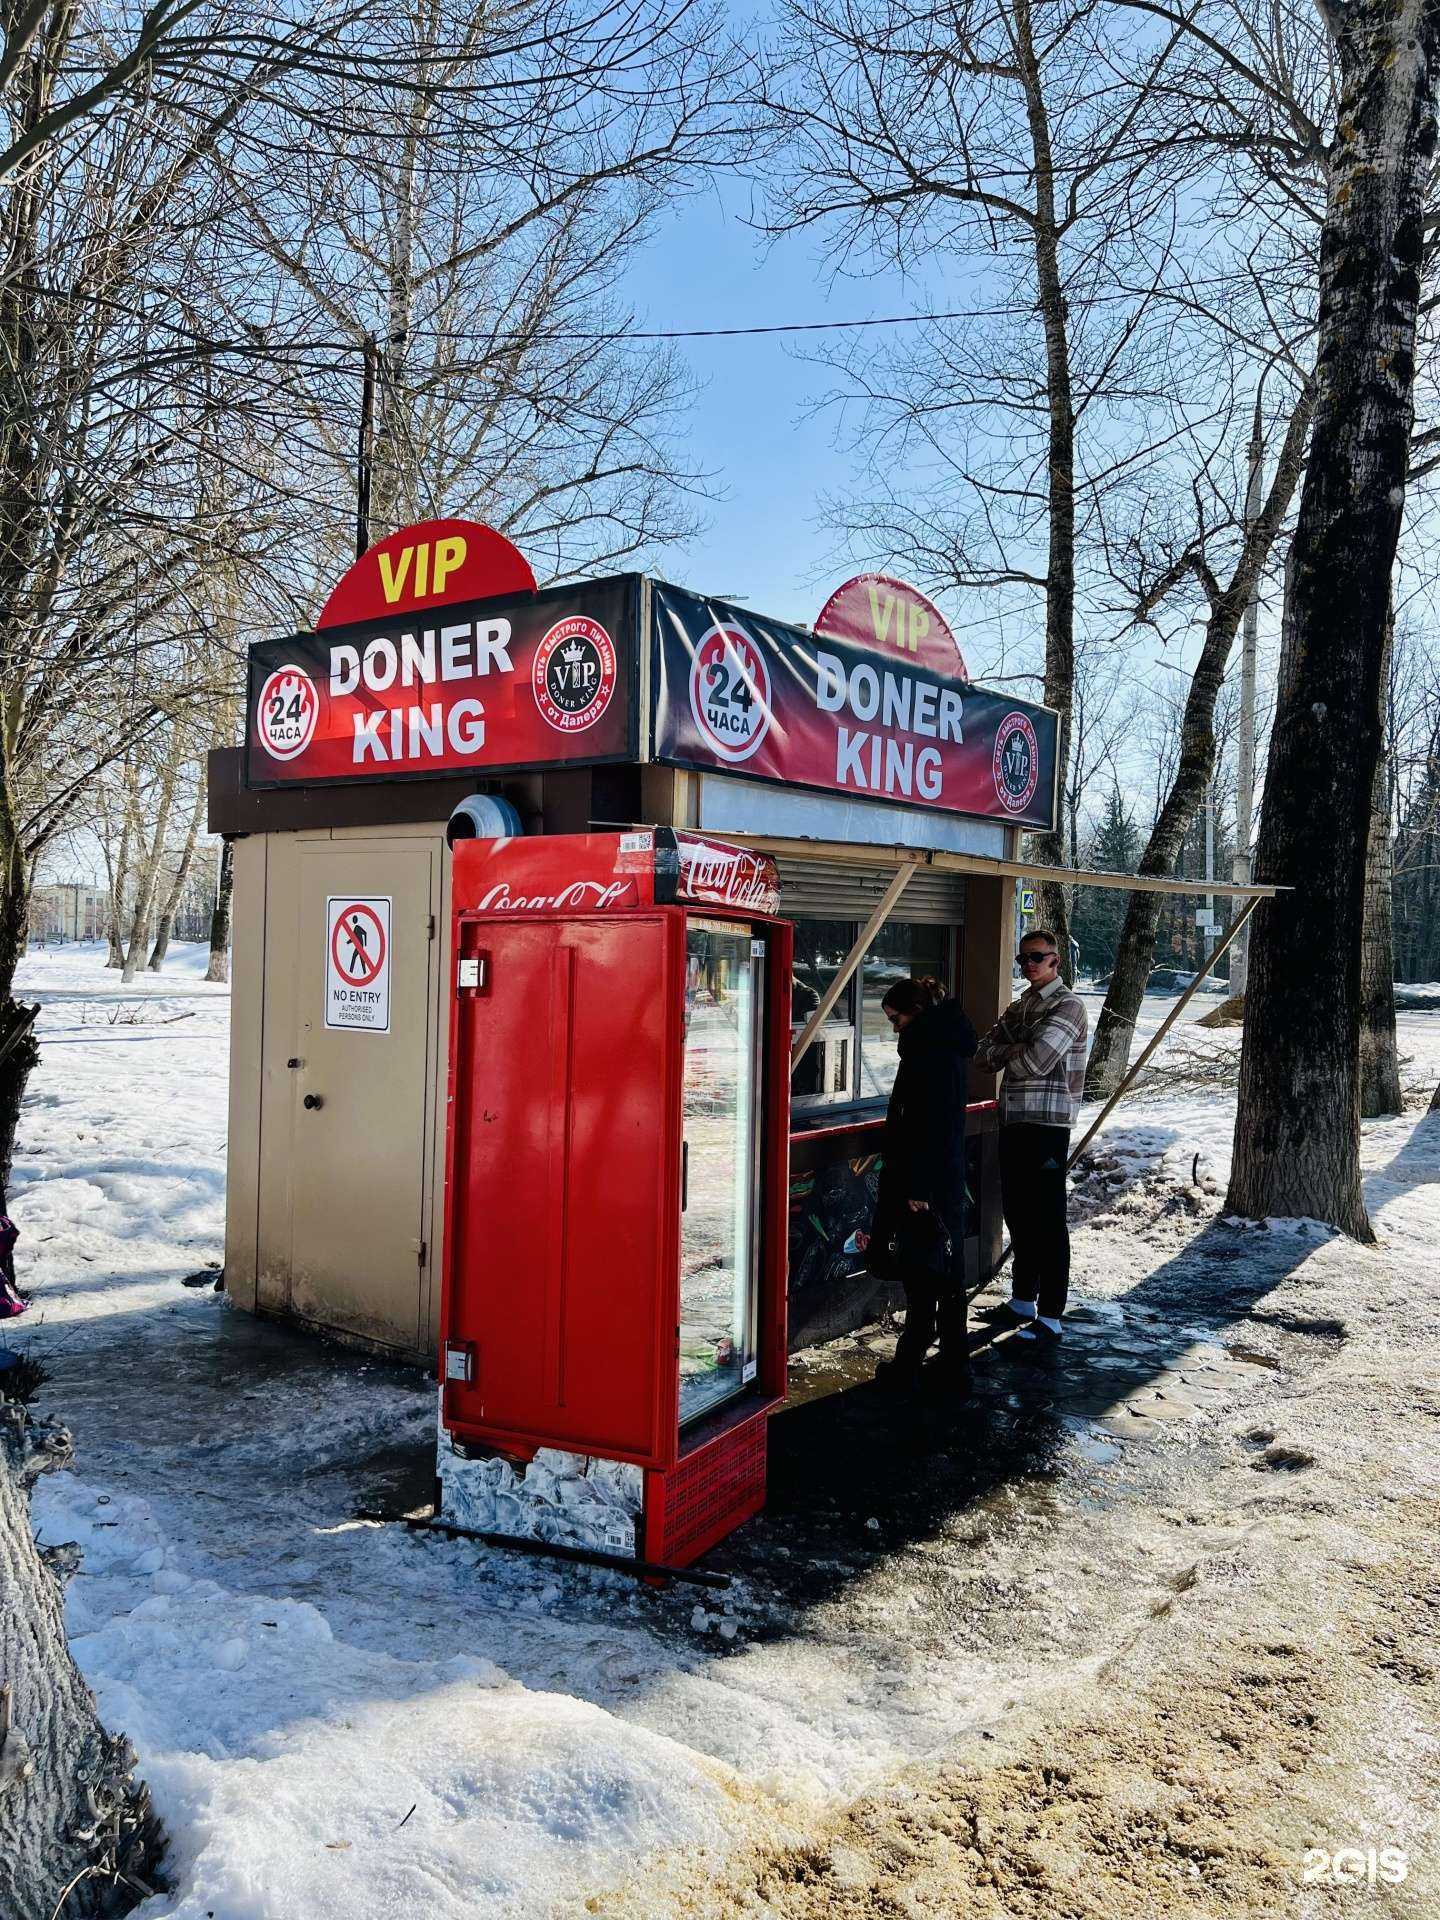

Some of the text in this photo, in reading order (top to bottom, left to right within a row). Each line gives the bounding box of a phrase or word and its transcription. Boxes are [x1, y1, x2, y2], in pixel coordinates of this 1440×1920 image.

[378, 536, 467, 604] VIP
[868, 587, 930, 653] VIP
[329, 617, 515, 697] DONER
[536, 622, 613, 684] СЕТЬ БЫСТРОГО ПИТАНИЯ
[554, 661, 596, 690] VIP
[707, 663, 753, 714] 24
[550, 677, 598, 708] DONER KING
[816, 650, 965, 745] DONER
[270, 693, 301, 726] 24
[547, 699, 603, 728] от Далера
[707, 708, 751, 737] ЧАСА
[270, 725, 301, 742] ЧАСА
[352, 698, 485, 763] KING
[836, 726, 944, 801] KING
[1005, 751, 1028, 776] VIP
[333, 989, 381, 1003] NO ENTRY
[341, 1004, 373, 1014] AUTHORISED
[338, 1012, 375, 1022] PERSONS ONLY
